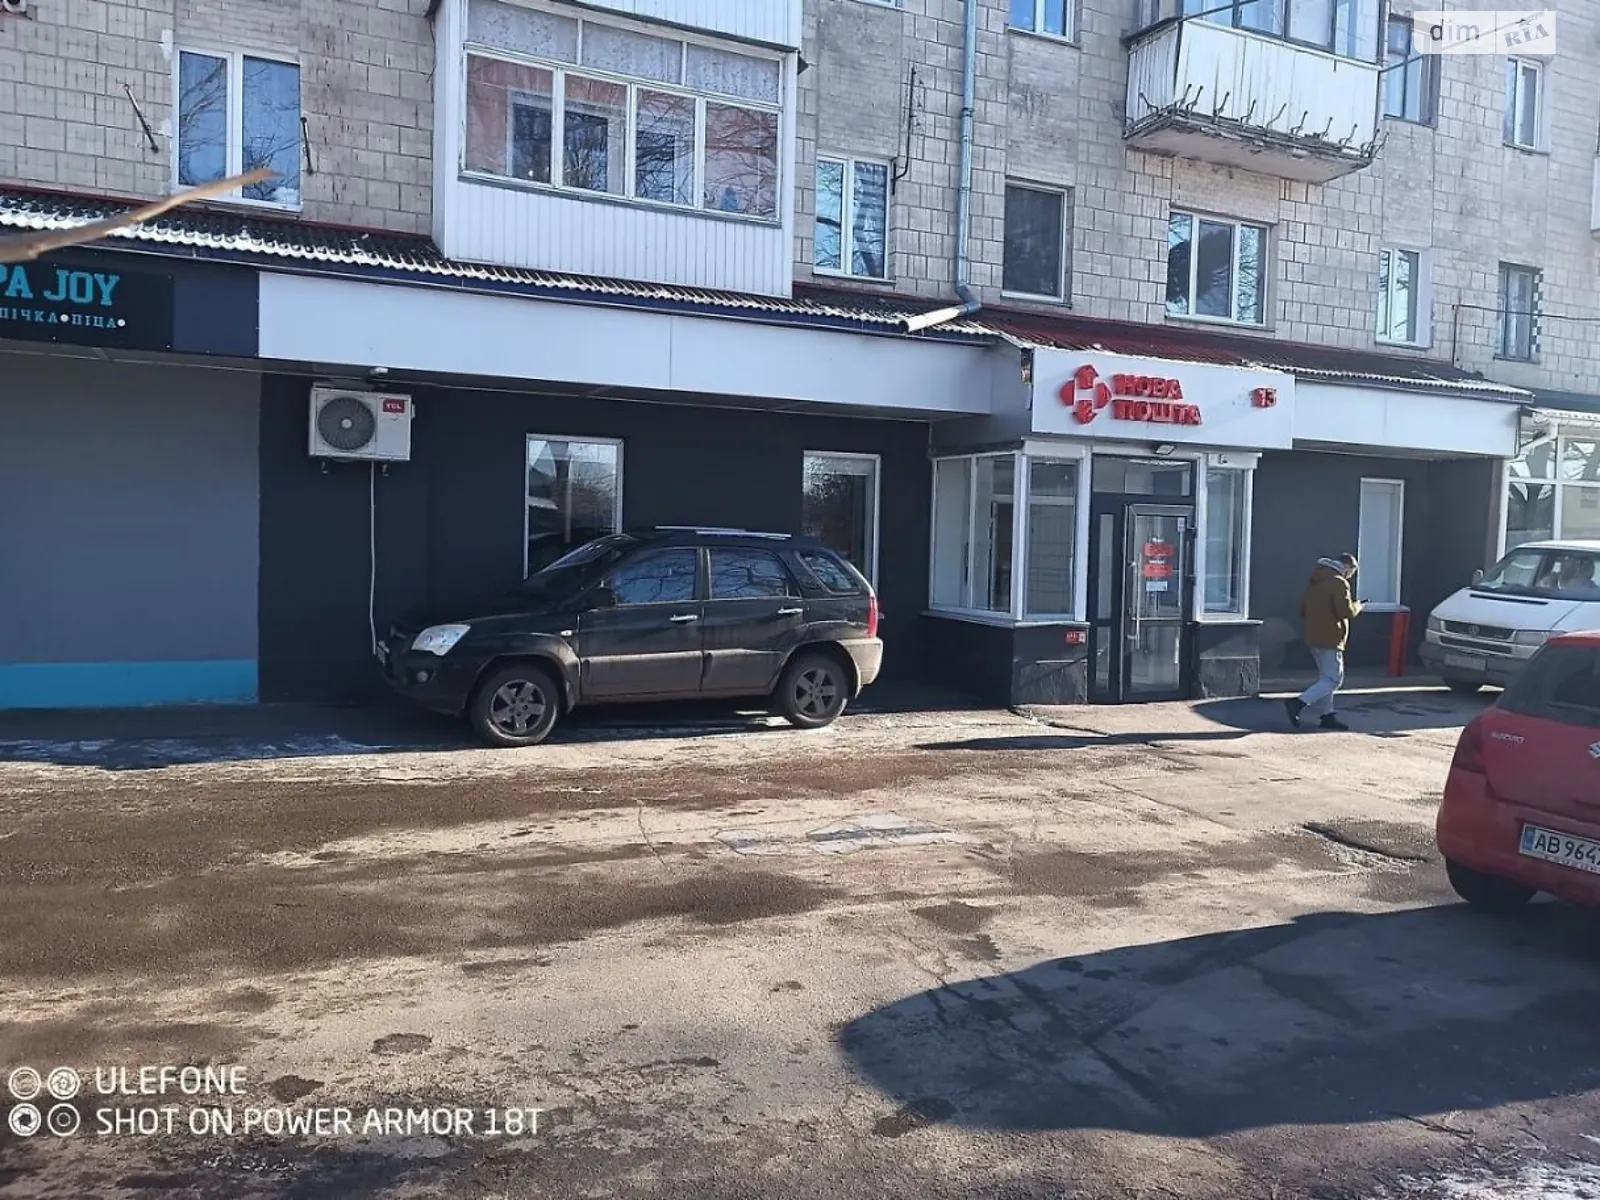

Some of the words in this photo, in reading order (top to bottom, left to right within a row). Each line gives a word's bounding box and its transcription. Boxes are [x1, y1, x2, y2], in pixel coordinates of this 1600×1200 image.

[43, 269, 120, 306] JOY
[1112, 374, 1184, 399] НОВА
[1112, 399, 1203, 426] ПОШТА
[1534, 833, 1560, 855] AB
[1565, 841, 1600, 866] 964
